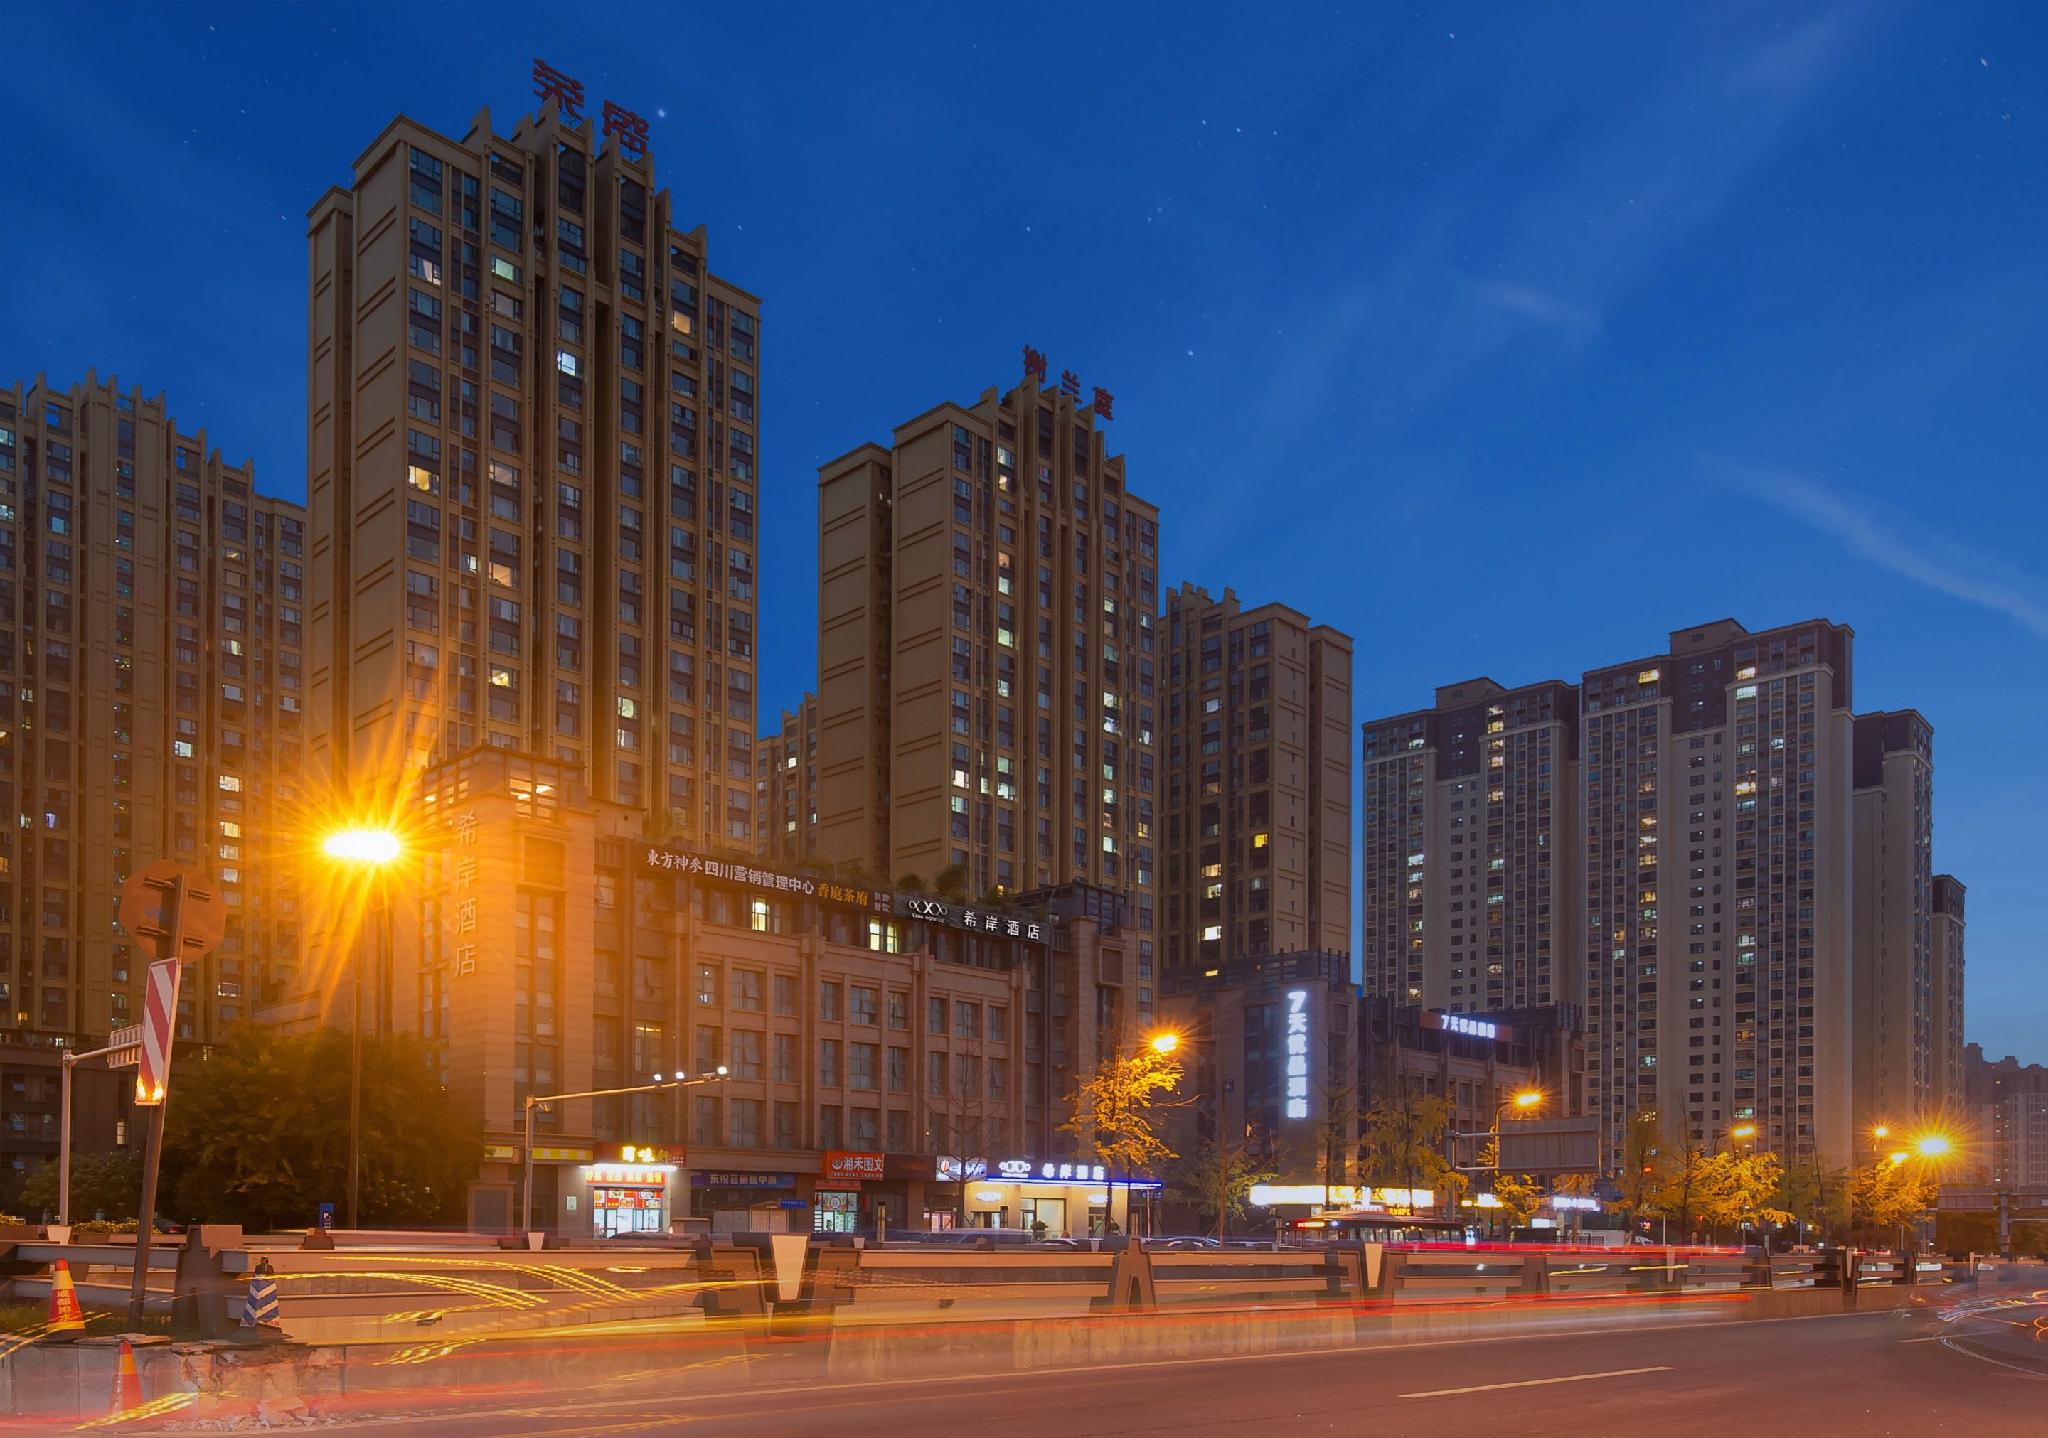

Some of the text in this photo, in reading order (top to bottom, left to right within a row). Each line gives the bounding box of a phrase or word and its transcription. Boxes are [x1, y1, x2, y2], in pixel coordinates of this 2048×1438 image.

[454, 810, 478, 978] 希岸酒店
[964, 910, 1040, 940] 希岸酒店
